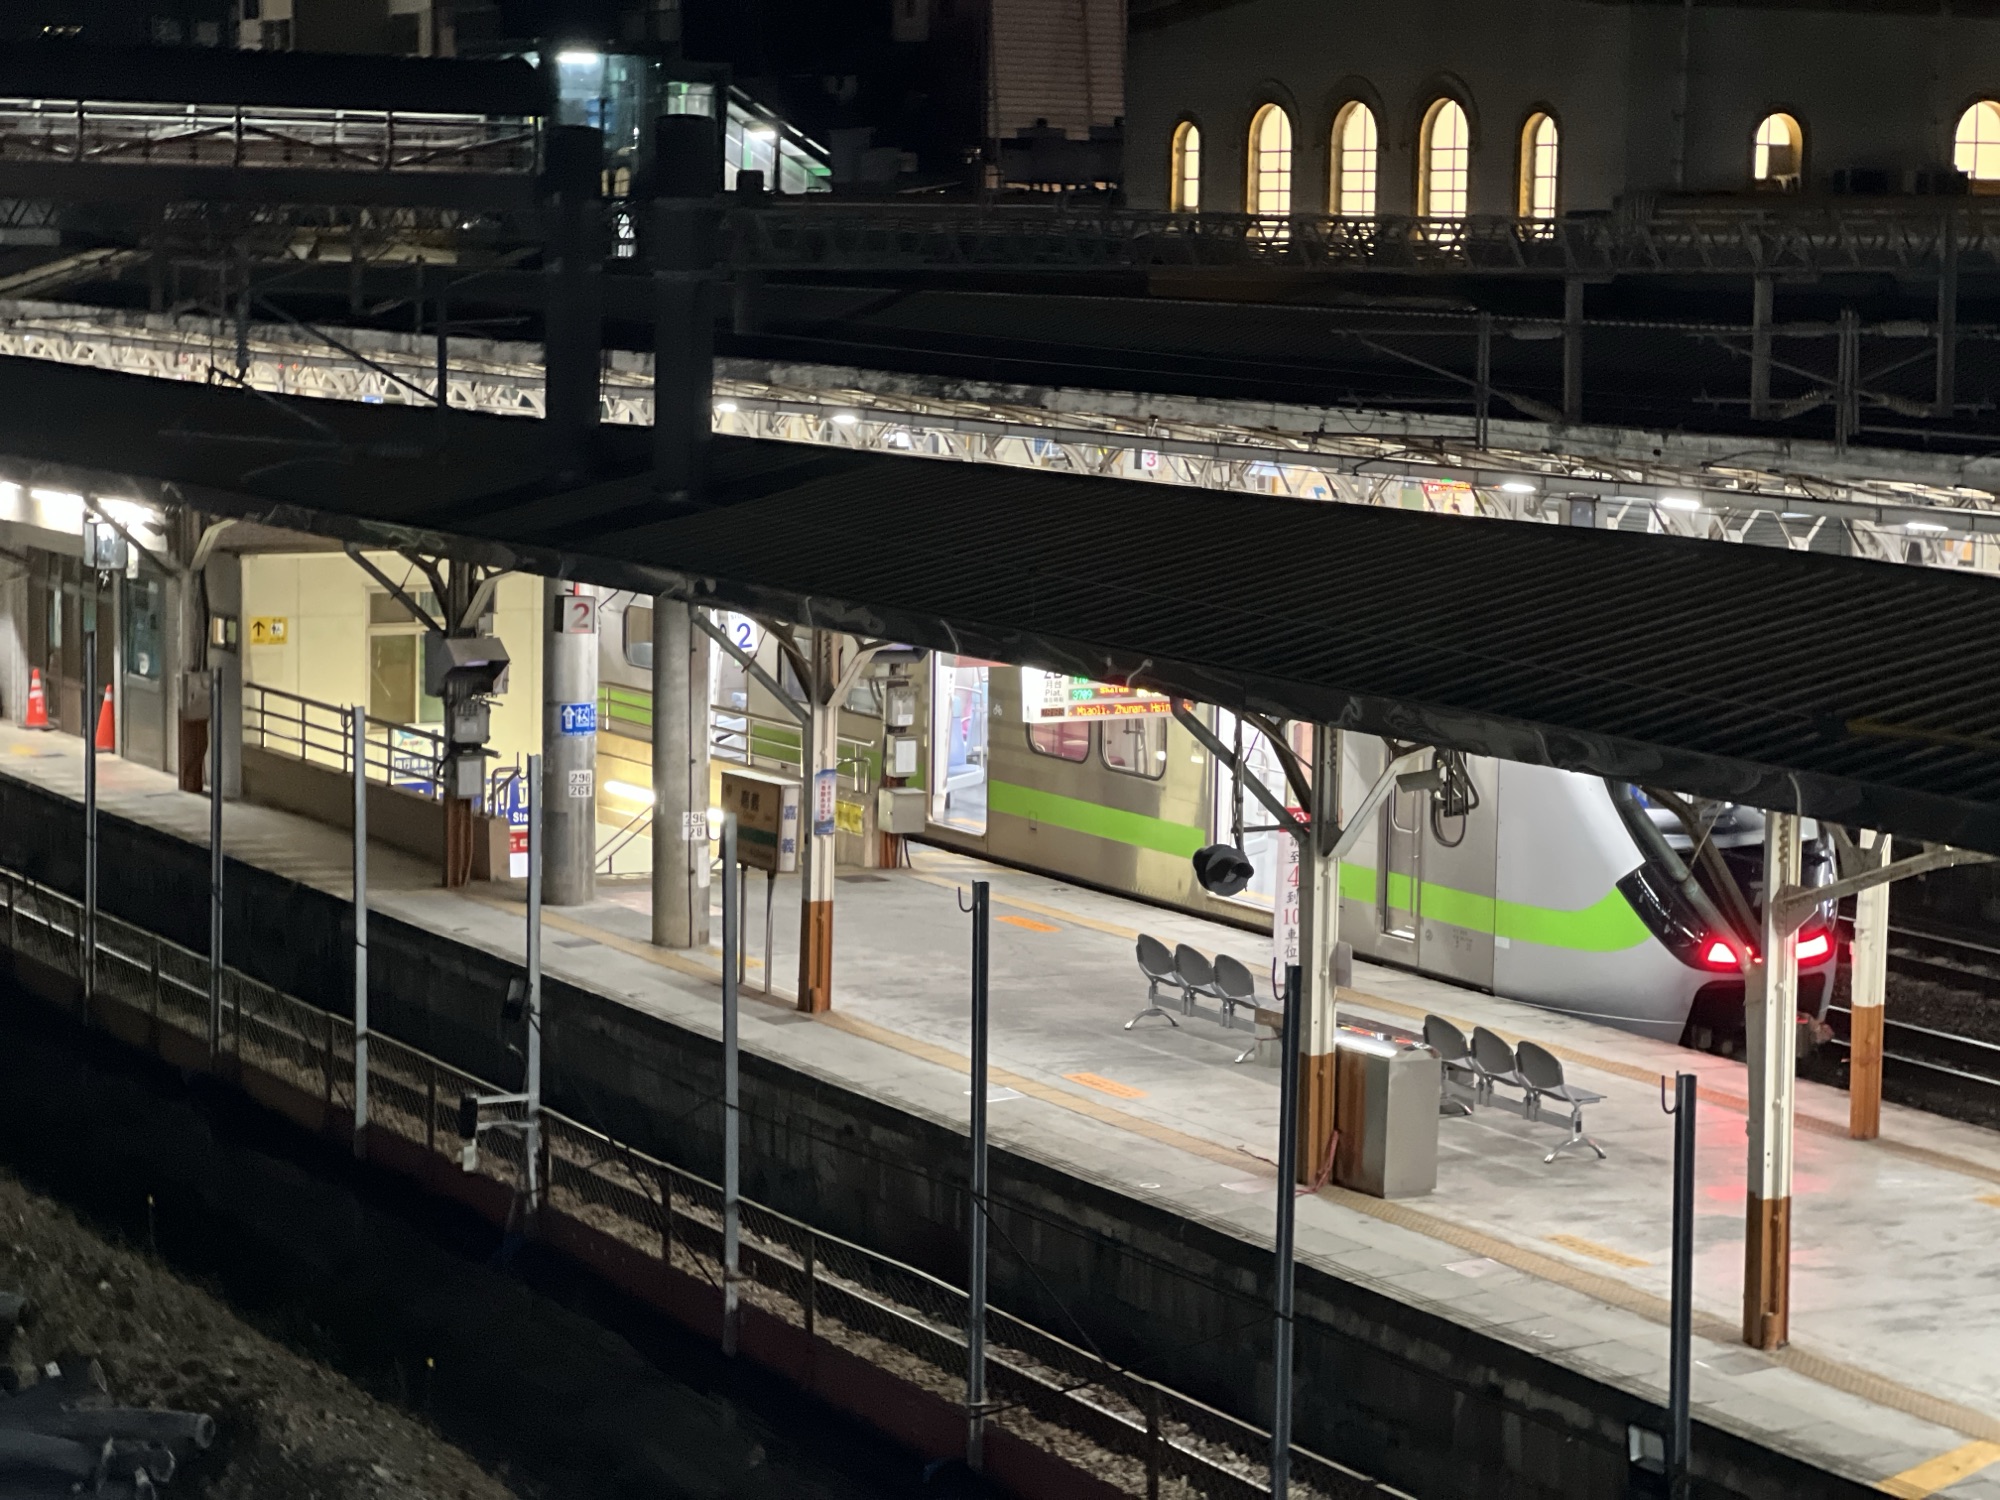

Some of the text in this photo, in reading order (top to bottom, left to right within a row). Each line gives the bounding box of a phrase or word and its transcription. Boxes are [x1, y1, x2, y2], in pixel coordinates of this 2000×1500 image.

[1146, 452, 1156, 467] 3
[572, 602, 589, 629] 2
[736, 622, 753, 649] 2
[1045, 689, 1063, 697] Plat.
